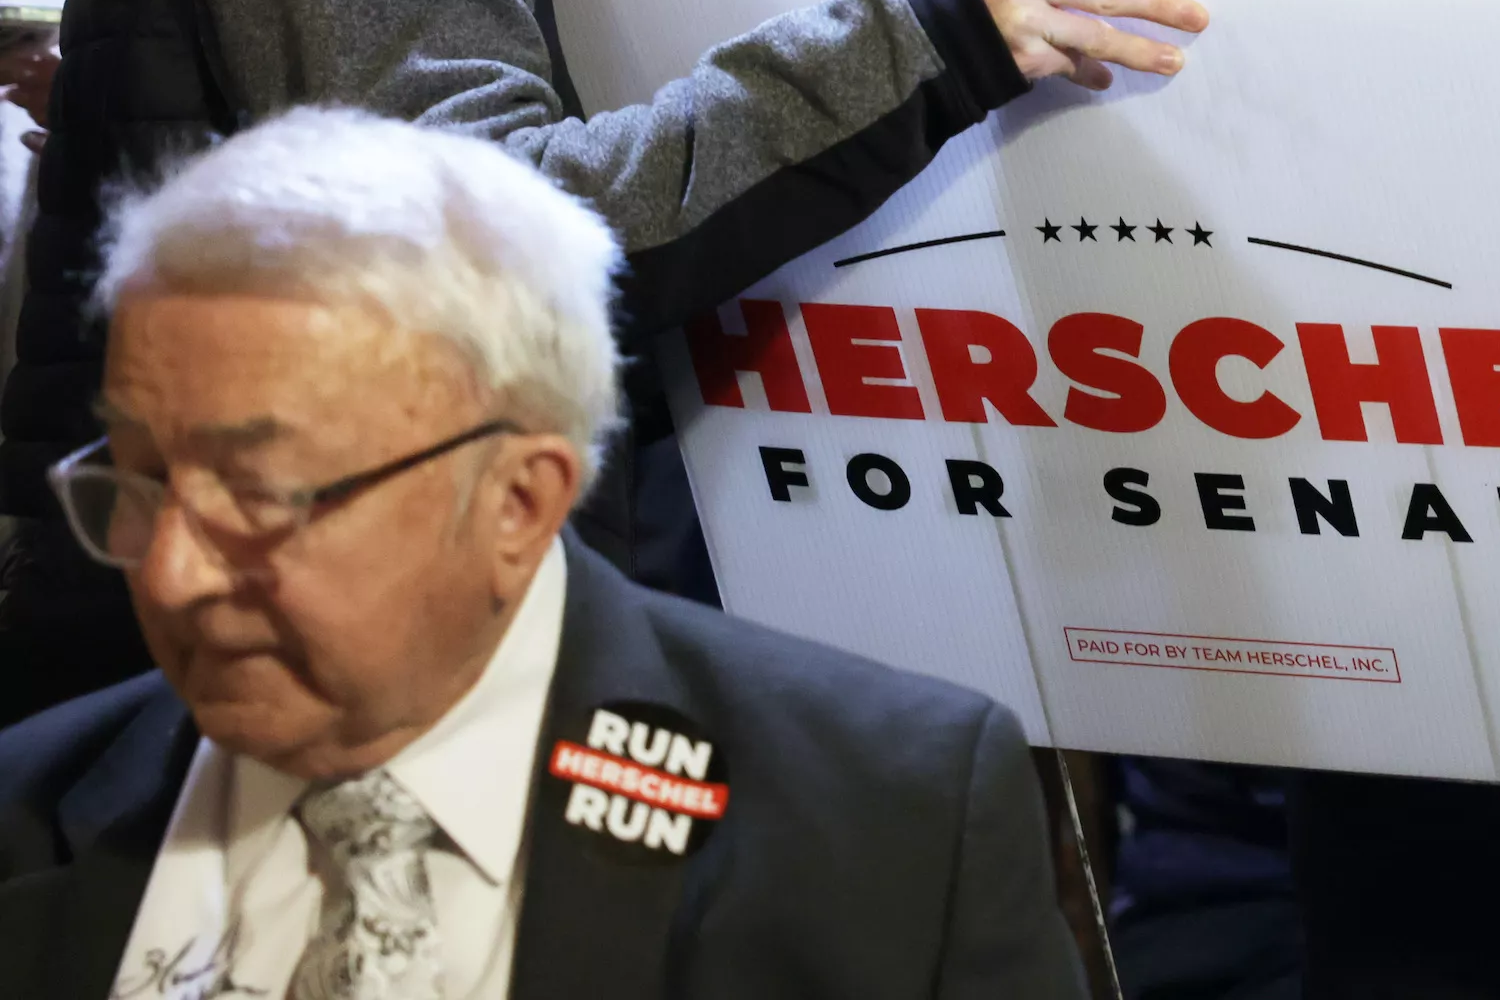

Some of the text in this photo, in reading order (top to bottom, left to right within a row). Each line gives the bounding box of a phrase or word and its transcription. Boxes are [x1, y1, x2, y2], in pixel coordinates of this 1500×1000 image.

[758, 446, 1013, 517] FOR
[1077, 639, 1389, 673] PAID FOR BY TEAM HERSCHEL, INC.
[587, 708, 712, 781] RUN
[556, 747, 720, 815] HERSCHEL
[565, 783, 692, 855] RUN
